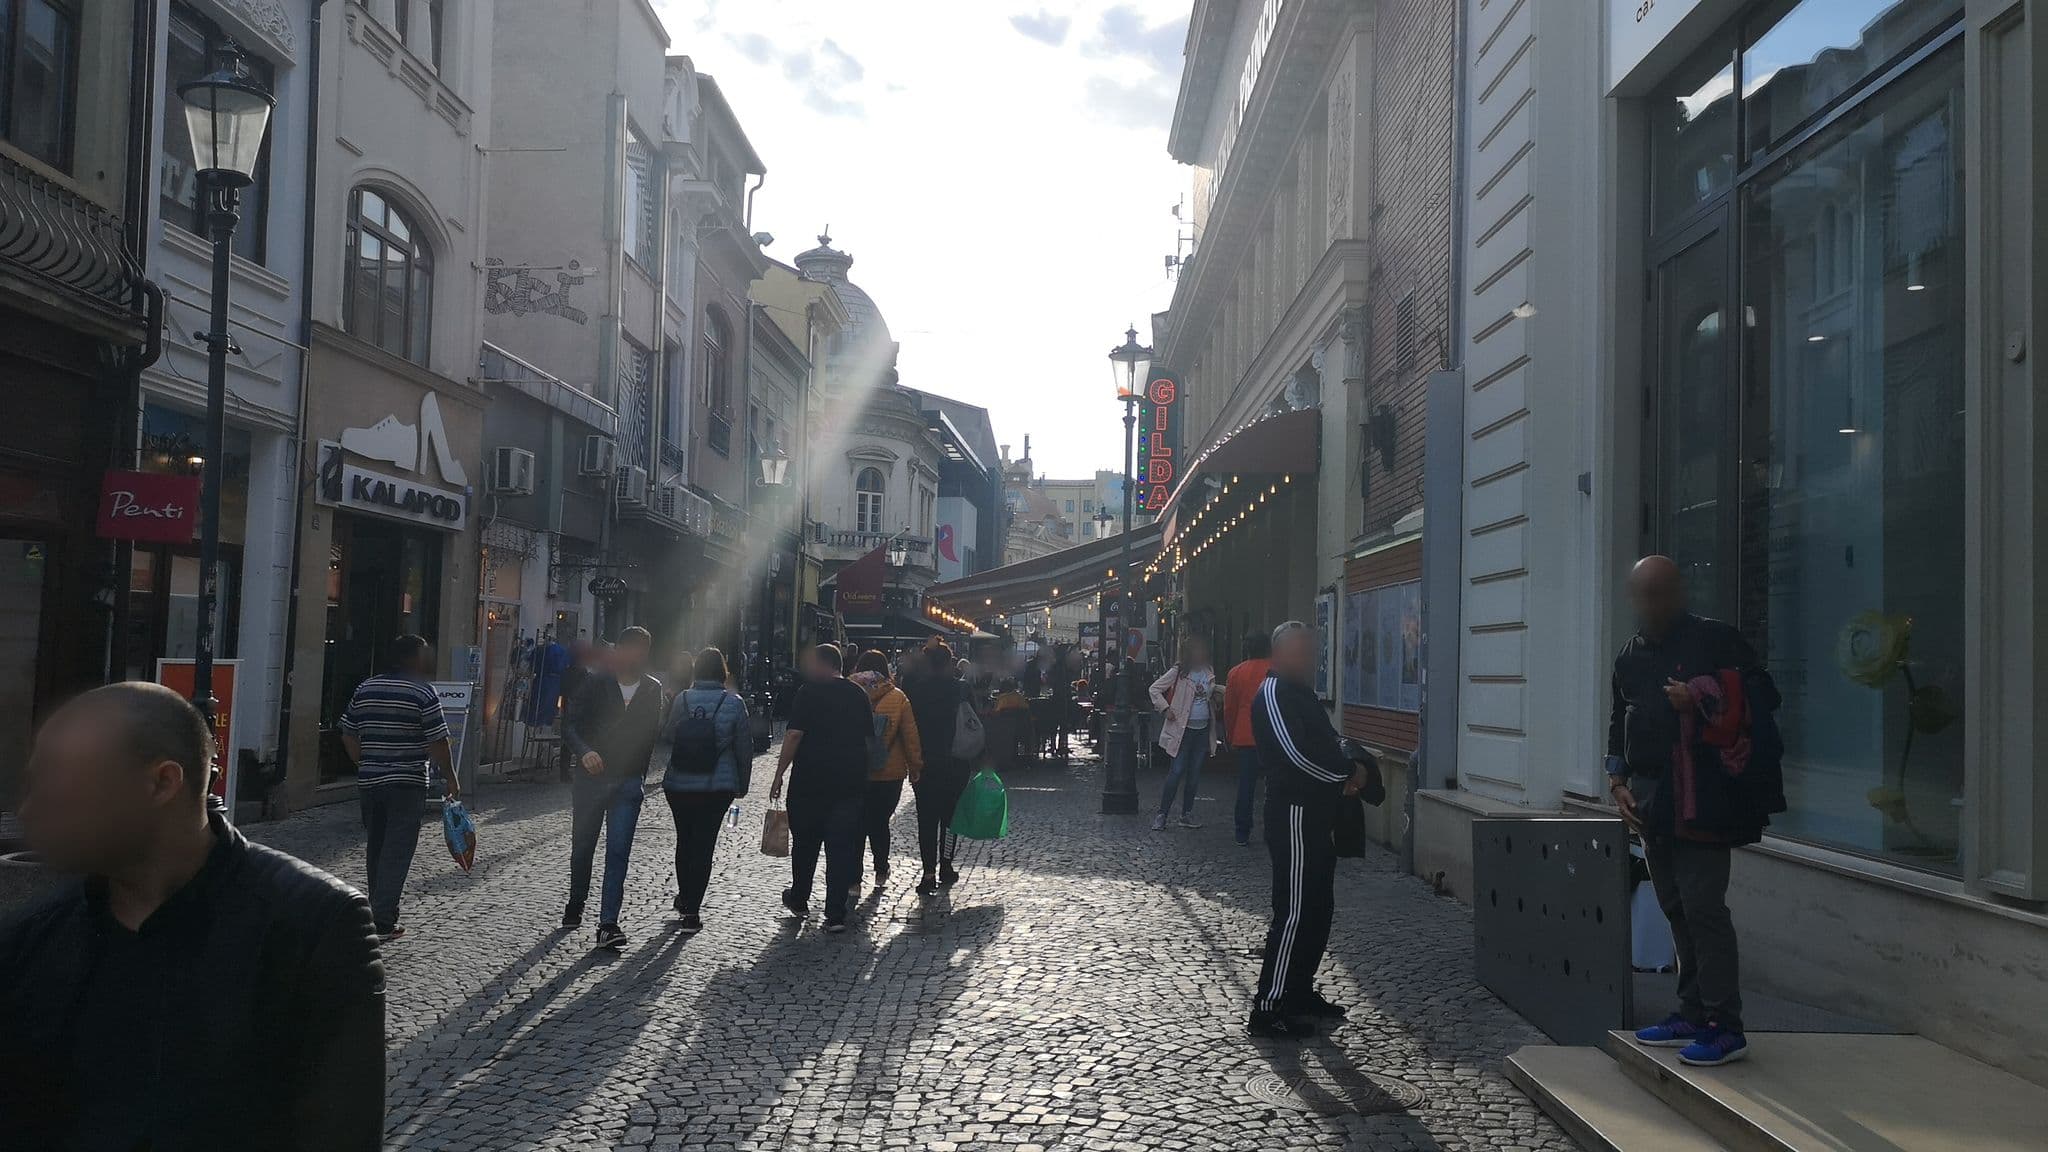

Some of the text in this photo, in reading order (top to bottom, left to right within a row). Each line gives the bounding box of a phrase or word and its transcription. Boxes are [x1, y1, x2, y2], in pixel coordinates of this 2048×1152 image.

[1145, 378, 1176, 510] GILDA
[110, 490, 184, 520] Penti
[352, 474, 461, 522] KALAPOD
